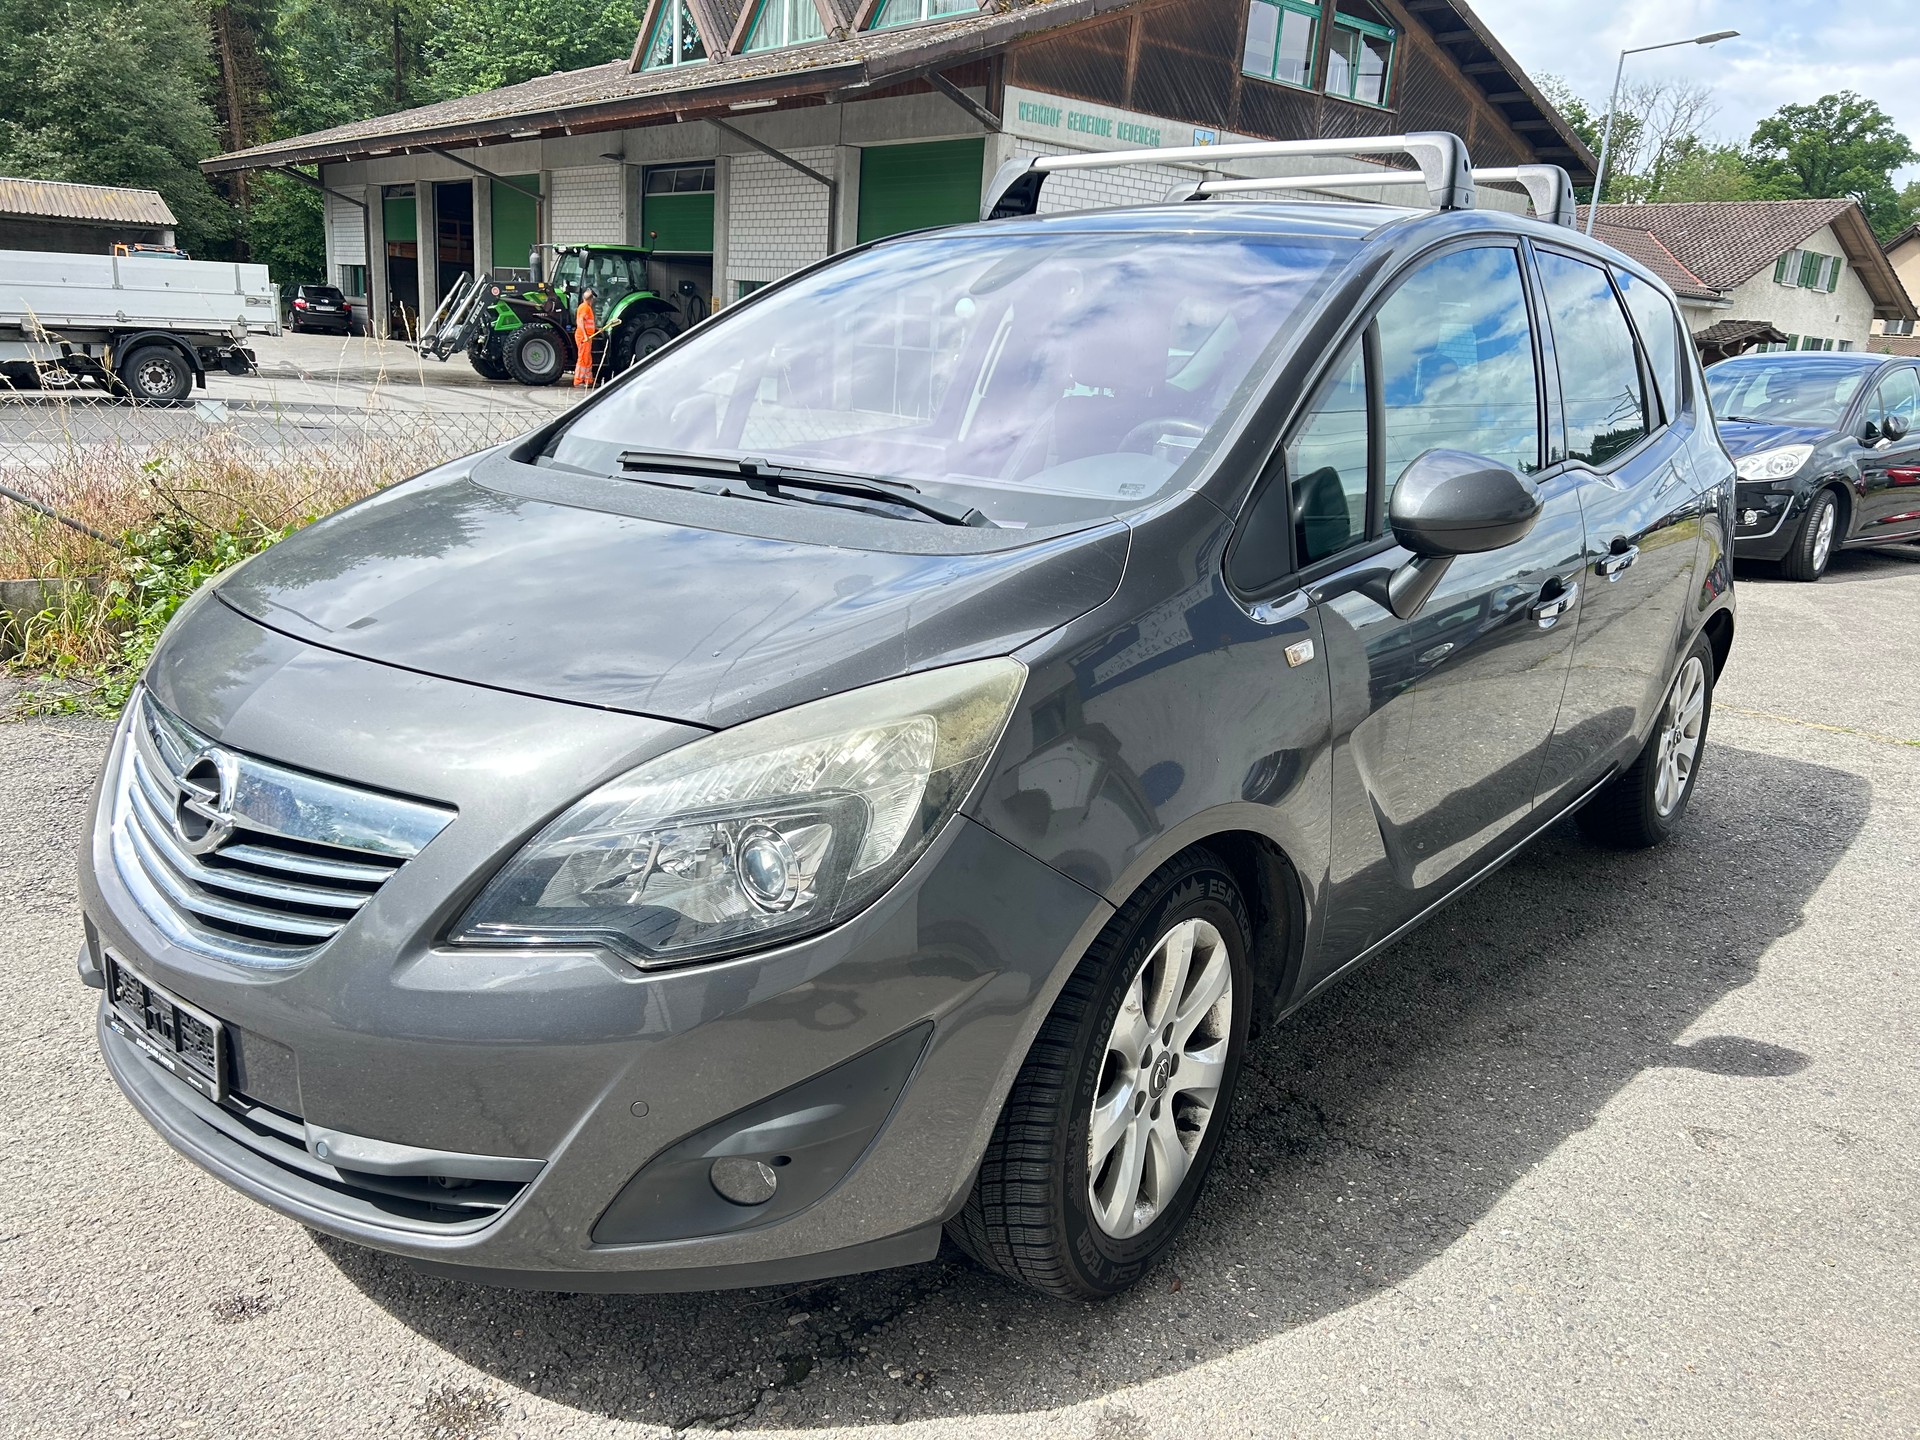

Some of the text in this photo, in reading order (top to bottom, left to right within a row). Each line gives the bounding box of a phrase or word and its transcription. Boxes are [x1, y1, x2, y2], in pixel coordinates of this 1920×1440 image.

[1018, 100, 1160, 148] WERKHOF GEMEINDE NEUENEGG
[1082, 986, 1121, 1097] SUPERGRIP
